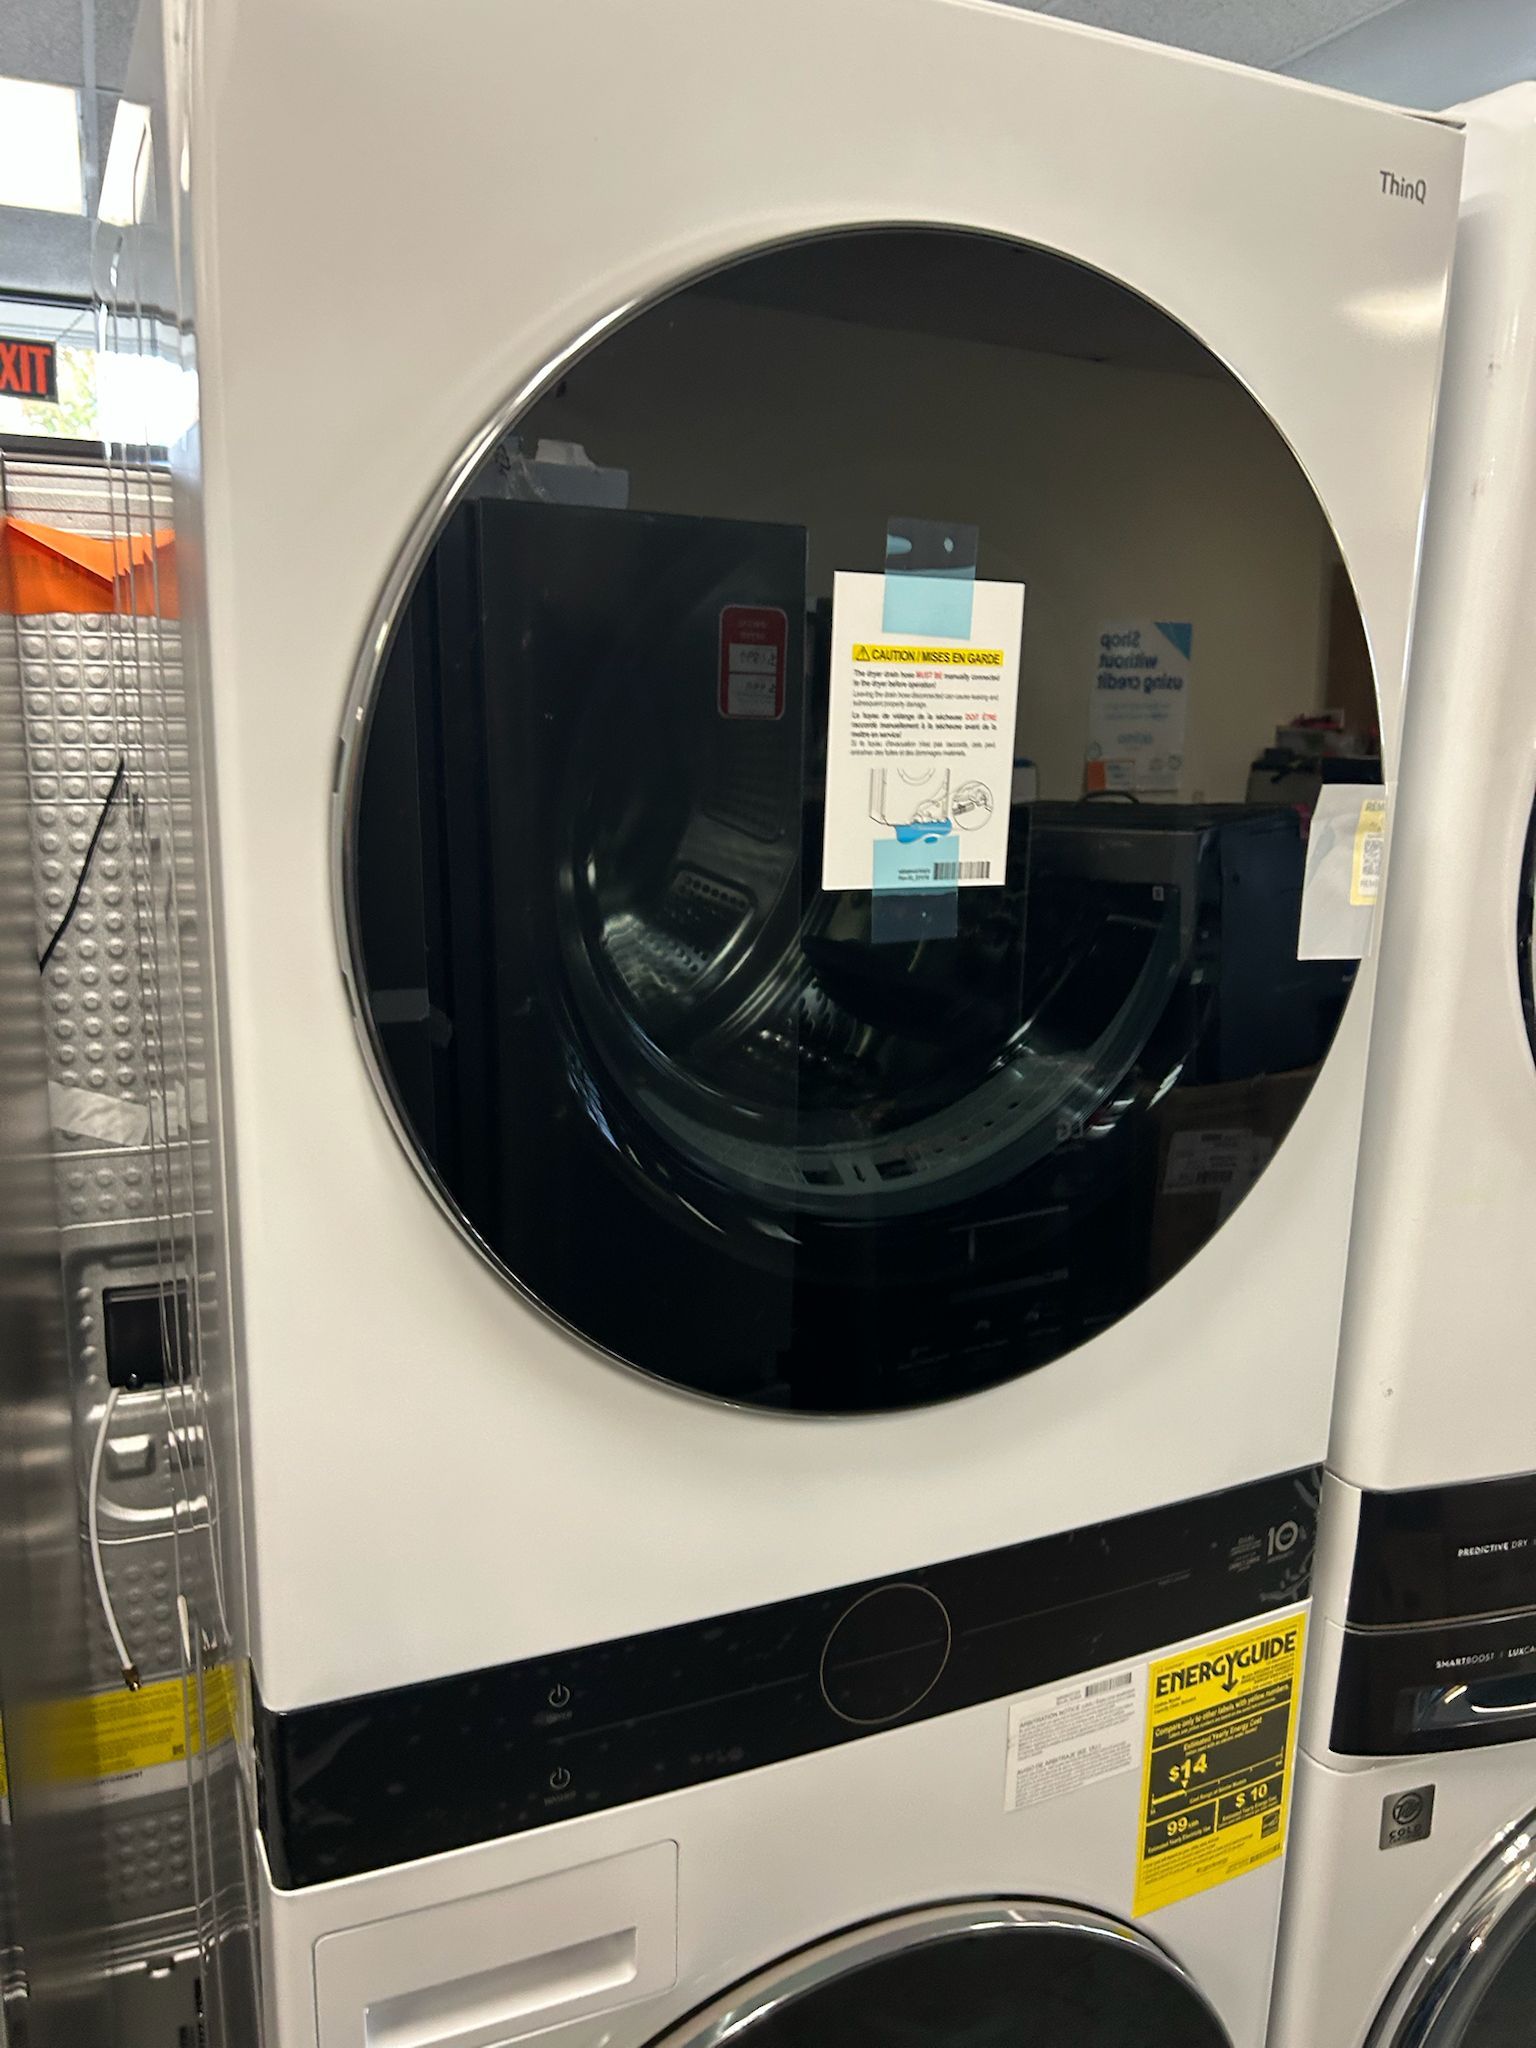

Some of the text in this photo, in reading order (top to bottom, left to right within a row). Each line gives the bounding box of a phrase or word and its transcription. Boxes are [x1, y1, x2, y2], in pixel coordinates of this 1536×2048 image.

[1380, 170, 1426, 204] ThinQ
[0, 342, 51, 395] XIT
[873, 649, 914, 661] CAUTION
[922, 651, 951, 662] MISES
[953, 653, 965, 663] EN
[968, 653, 1000, 664] GARDE
[867, 671, 881, 679] dryer
[945, 672, 969, 681] manually
[872, 681, 886, 689] dryer
[1366, 801, 1385, 812] REM
[1457, 1539, 1528, 1558] PREDICTIVE DRY
[1156, 1631, 1297, 1698] ENERGYGUIDE
[1435, 1645, 1536, 1670] SMARTBOOST LUXCA
[1154, 1720, 1181, 1737] Compare
[1181, 1715, 1194, 1728] only
[1200, 1707, 1218, 1719] other
[1218, 1701, 1234, 1713] labels
[1235, 1697, 1247, 1707] with
[1247, 1691, 1265, 1703] yellow
[1183, 1716, 1263, 1751] Estimated Yearly Energy Cost
[1168, 1753, 1208, 1783] $14
[1235, 1783, 1268, 1809] $ 10
[1166, 1816, 1188, 1837] 99
